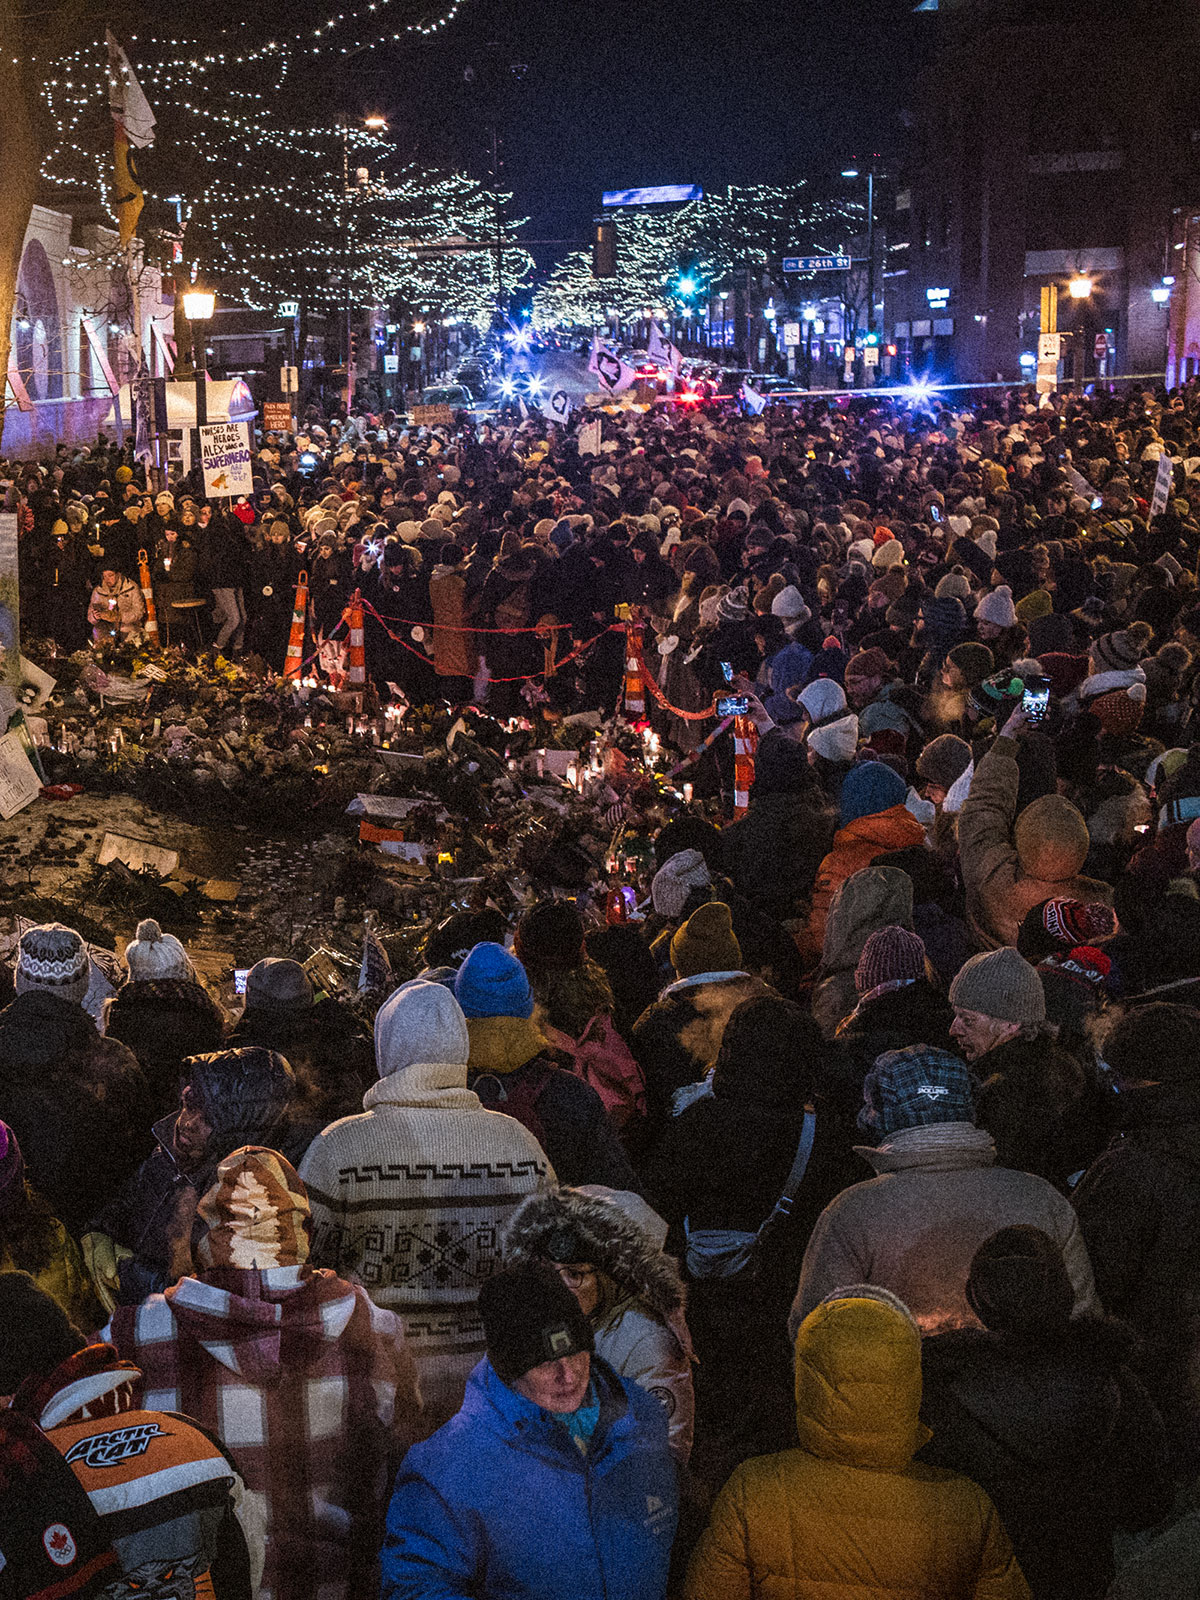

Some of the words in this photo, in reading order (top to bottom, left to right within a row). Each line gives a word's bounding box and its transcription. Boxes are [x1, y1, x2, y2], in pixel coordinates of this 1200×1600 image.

[808, 260, 833, 268] 26th
[837, 259, 848, 267] St
[202, 426, 224, 436] NURSES
[227, 424, 238, 432] ARE
[270, 421, 286, 429] HERO
[214, 433, 240, 443] HEROES
[204, 444, 224, 457] ALEX
[204, 449, 250, 470] SUPERHERO
[65, 1423, 162, 1463] ARCTIC
[85, 1436, 151, 1467] CAT
